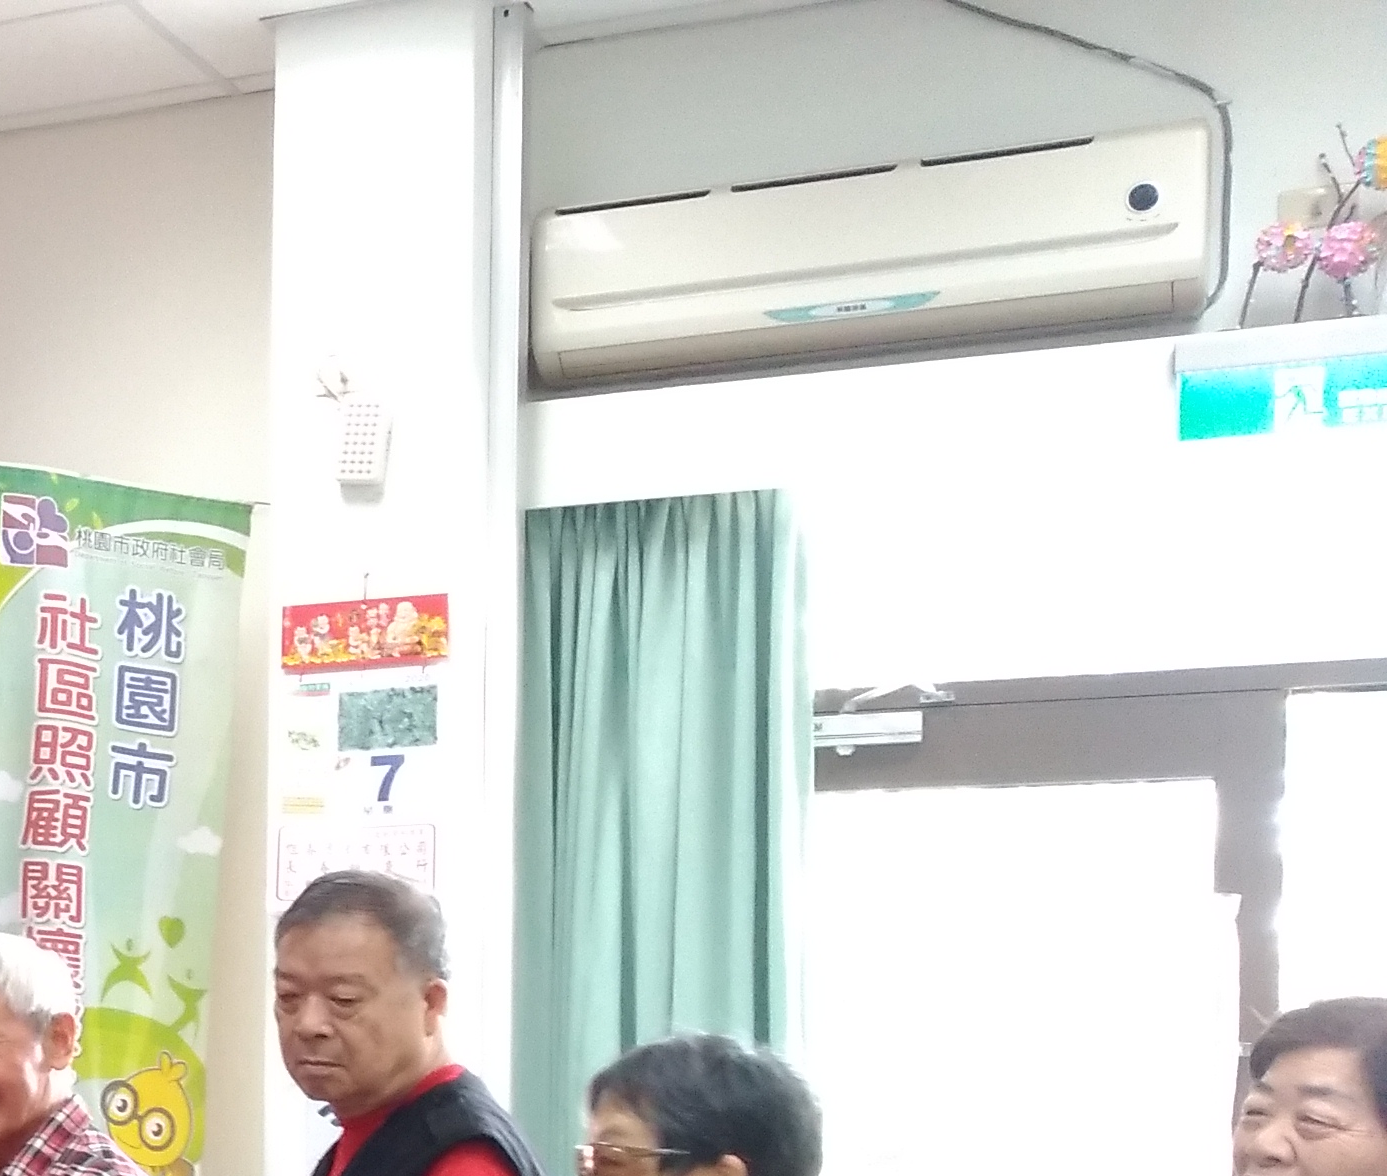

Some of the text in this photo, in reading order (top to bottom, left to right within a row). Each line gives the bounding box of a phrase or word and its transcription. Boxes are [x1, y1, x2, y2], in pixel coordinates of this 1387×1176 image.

[76, 528, 225, 571] 桃園市政府社會局
[110, 588, 184, 808] 桃園市
[371, 755, 403, 802] 7
